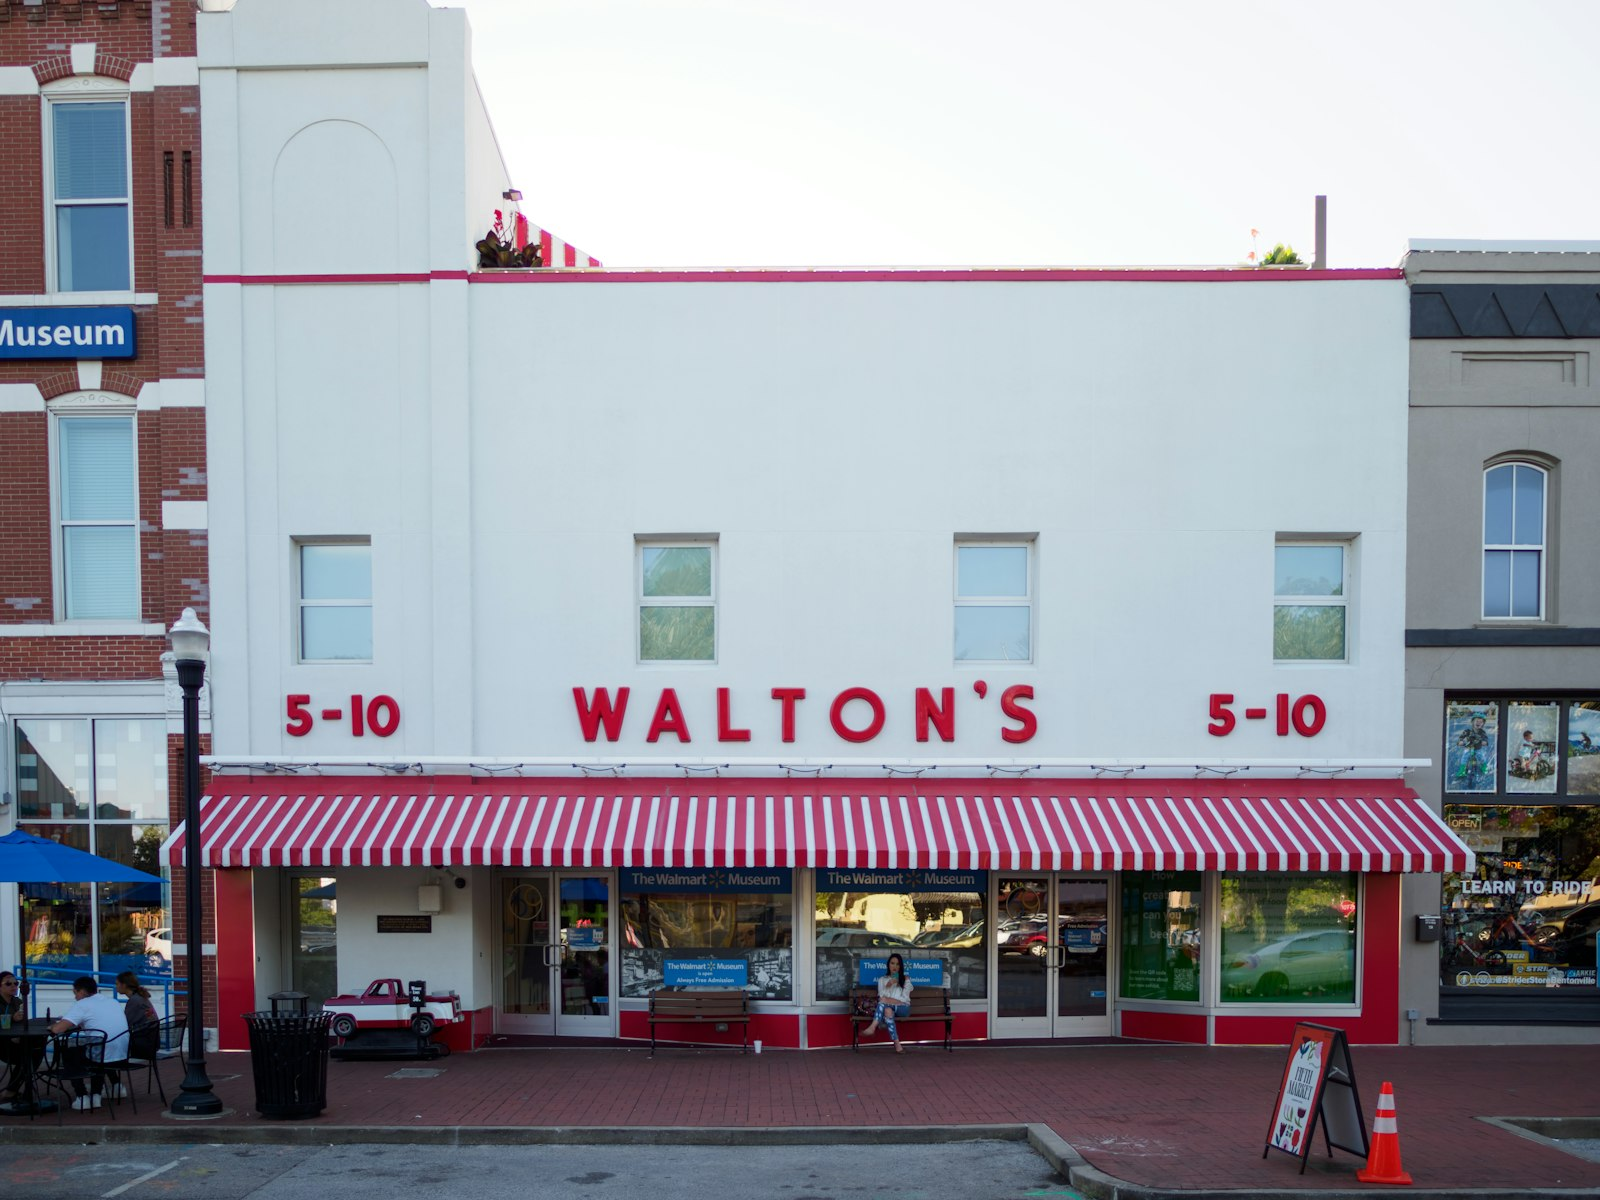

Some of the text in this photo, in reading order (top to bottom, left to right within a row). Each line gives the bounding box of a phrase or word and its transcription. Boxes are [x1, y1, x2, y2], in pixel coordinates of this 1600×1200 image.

[286, 694, 401, 737] 5-10
[572, 680, 1038, 743] WALTON'S
[1208, 693, 1327, 737] 5-10
[1451, 819, 1478, 828] OPEN
[632, 873, 781, 885] The Walmart Museum
[828, 872, 975, 885] The Walmart Museum
[1462, 881, 1516, 894] LEARN
[1523, 881, 1545, 894] TO
